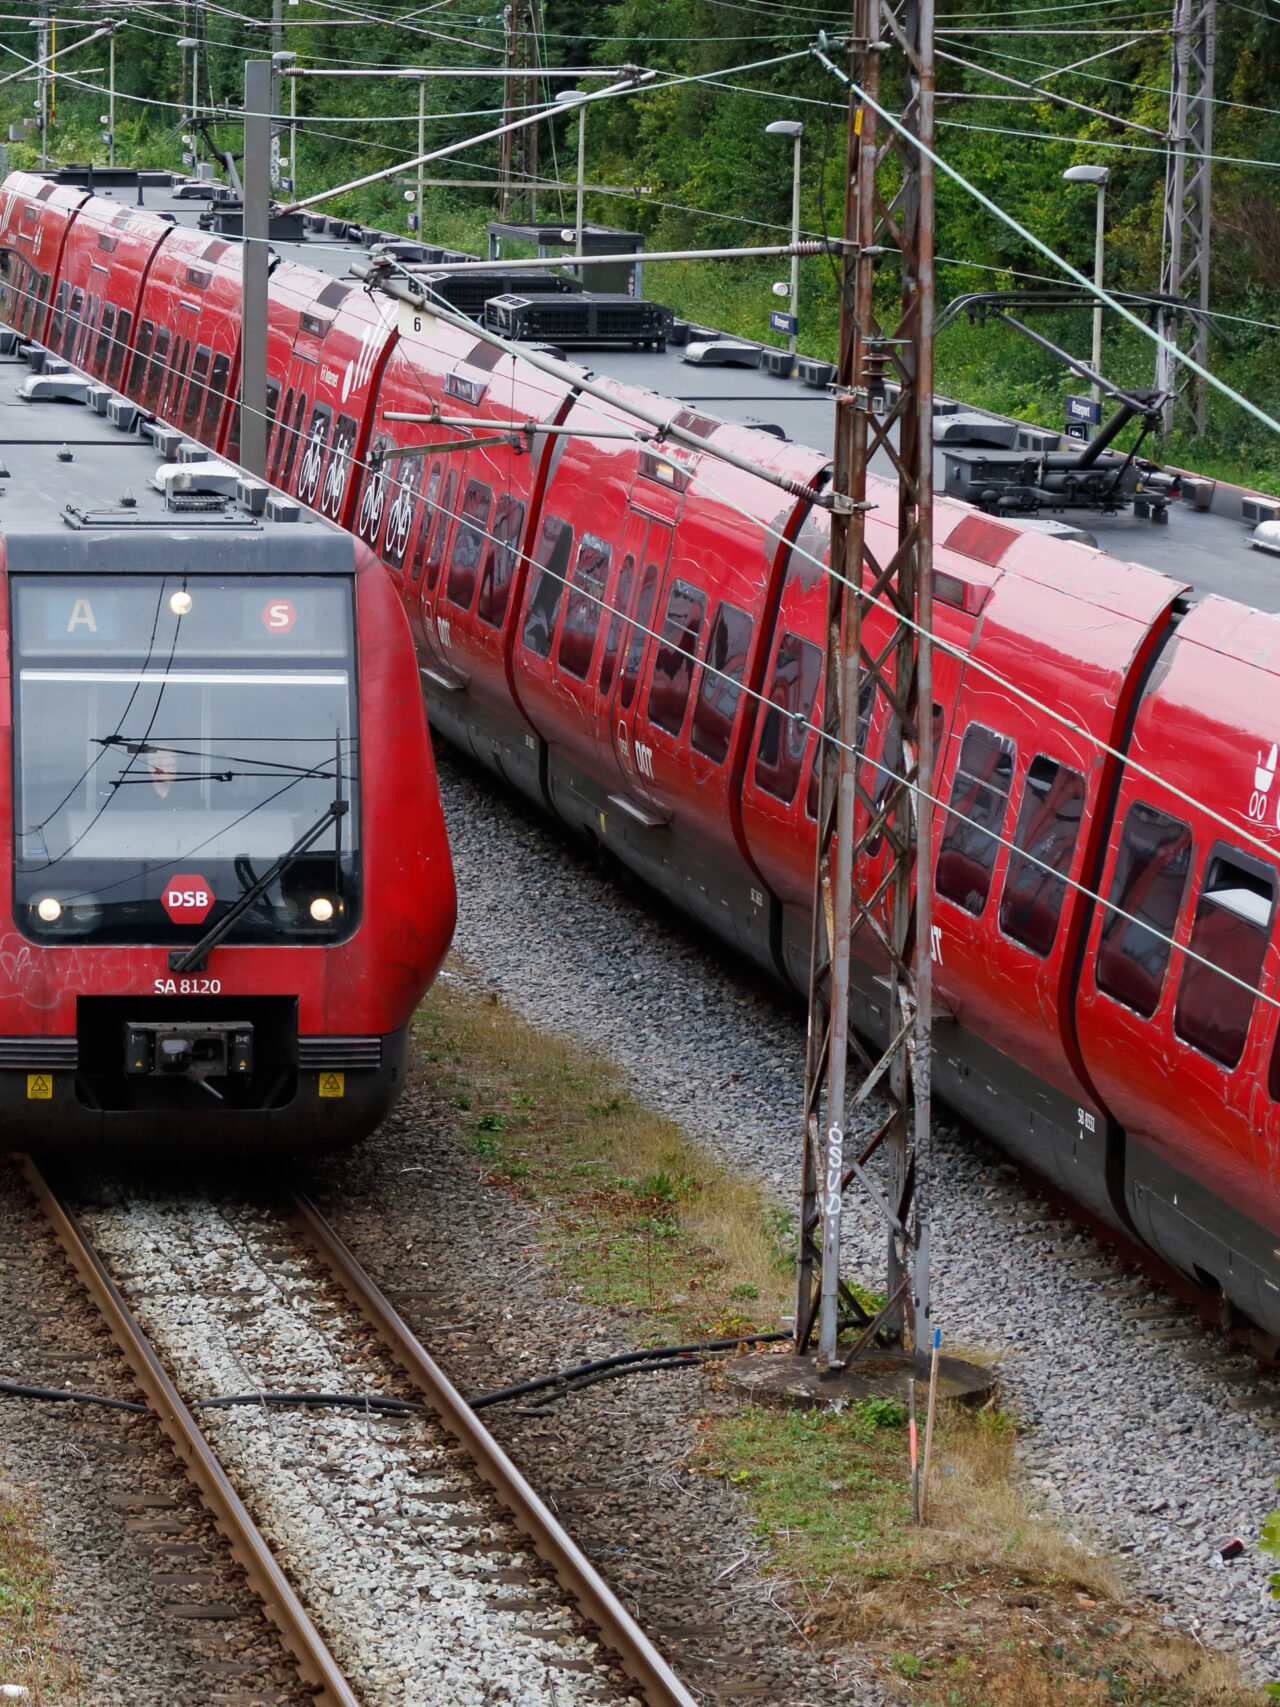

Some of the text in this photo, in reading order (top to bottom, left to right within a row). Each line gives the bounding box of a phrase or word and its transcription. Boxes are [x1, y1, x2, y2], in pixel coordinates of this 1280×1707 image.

[414, 317, 422, 332] 6
[66, 599, 98, 632] A
[269, 605, 289, 627] S
[634, 740, 654, 780] DOT
[168, 891, 209, 907] DSB
[154, 979, 221, 994] SA 8120
